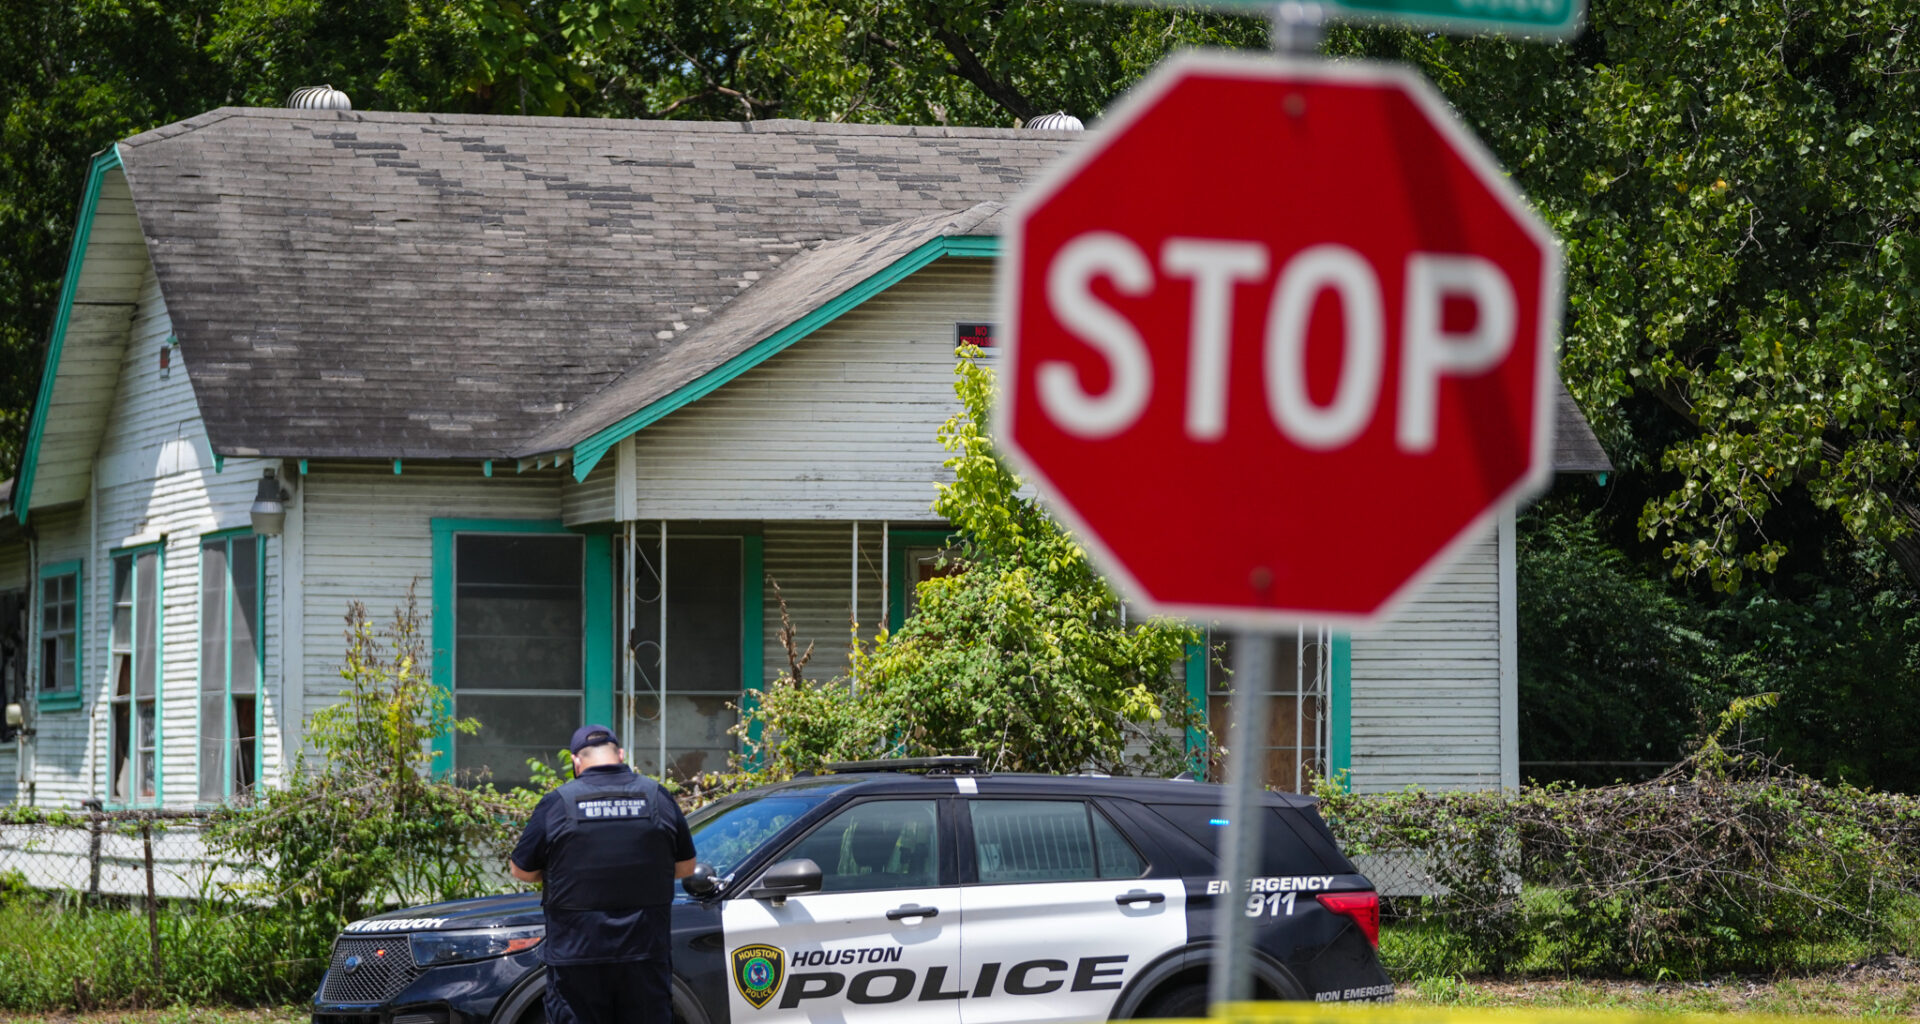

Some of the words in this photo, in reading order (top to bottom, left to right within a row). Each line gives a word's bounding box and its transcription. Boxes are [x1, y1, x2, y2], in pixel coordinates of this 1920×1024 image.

[975, 326, 988, 337] NO
[1036, 230, 1519, 454] STOP
[585, 806, 642, 818] UNIT
[1244, 892, 1297, 917] 911
[738, 949, 778, 960] HOUSTON
[791, 946, 903, 967] HOUSTON
[745, 986, 773, 998] POLICE
[778, 955, 1129, 1009] POLICE
[1315, 991, 1341, 1003] NON
[1343, 983, 1394, 999] EMERGENC
